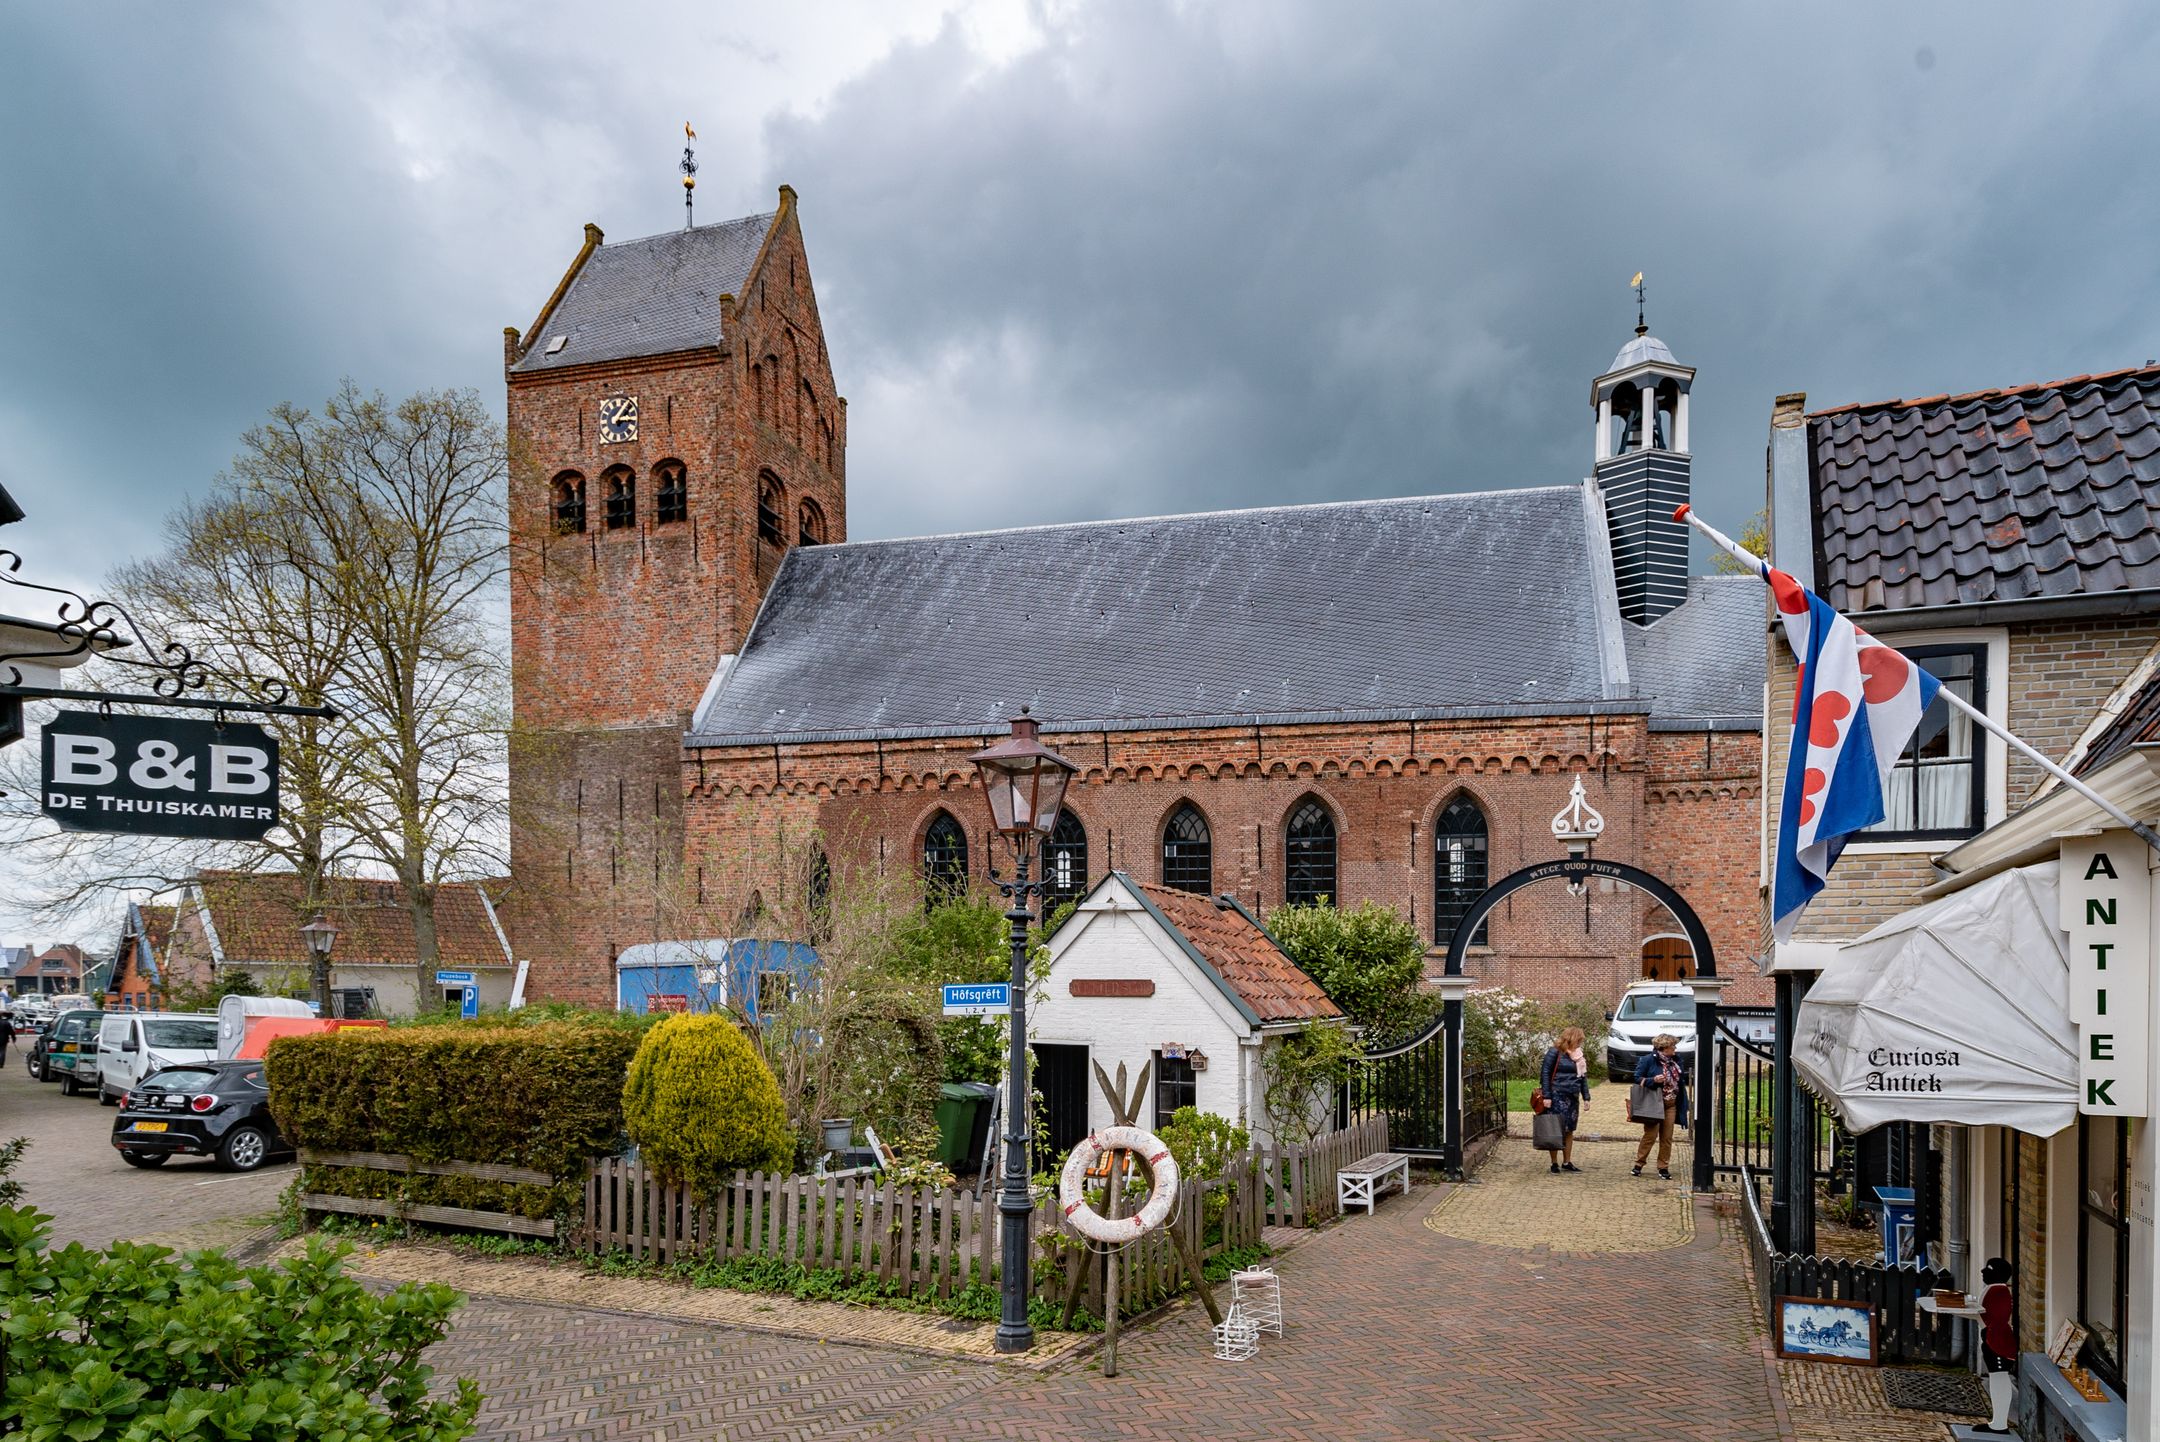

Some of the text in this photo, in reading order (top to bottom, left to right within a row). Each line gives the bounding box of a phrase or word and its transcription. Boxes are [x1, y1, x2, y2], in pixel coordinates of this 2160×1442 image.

[51, 733, 271, 795] B&B
[1564, 862, 1587, 871] QUOD
[1590, 863, 1613, 873] FUIT
[2084, 853, 2119, 1106] ANTIEK
[465, 988, 475, 1007] P
[951, 989, 1001, 1002] Hôfsgrêft
[1868, 1047, 1960, 1067] Curiosa
[1865, 1071, 1943, 1092] Antiek
